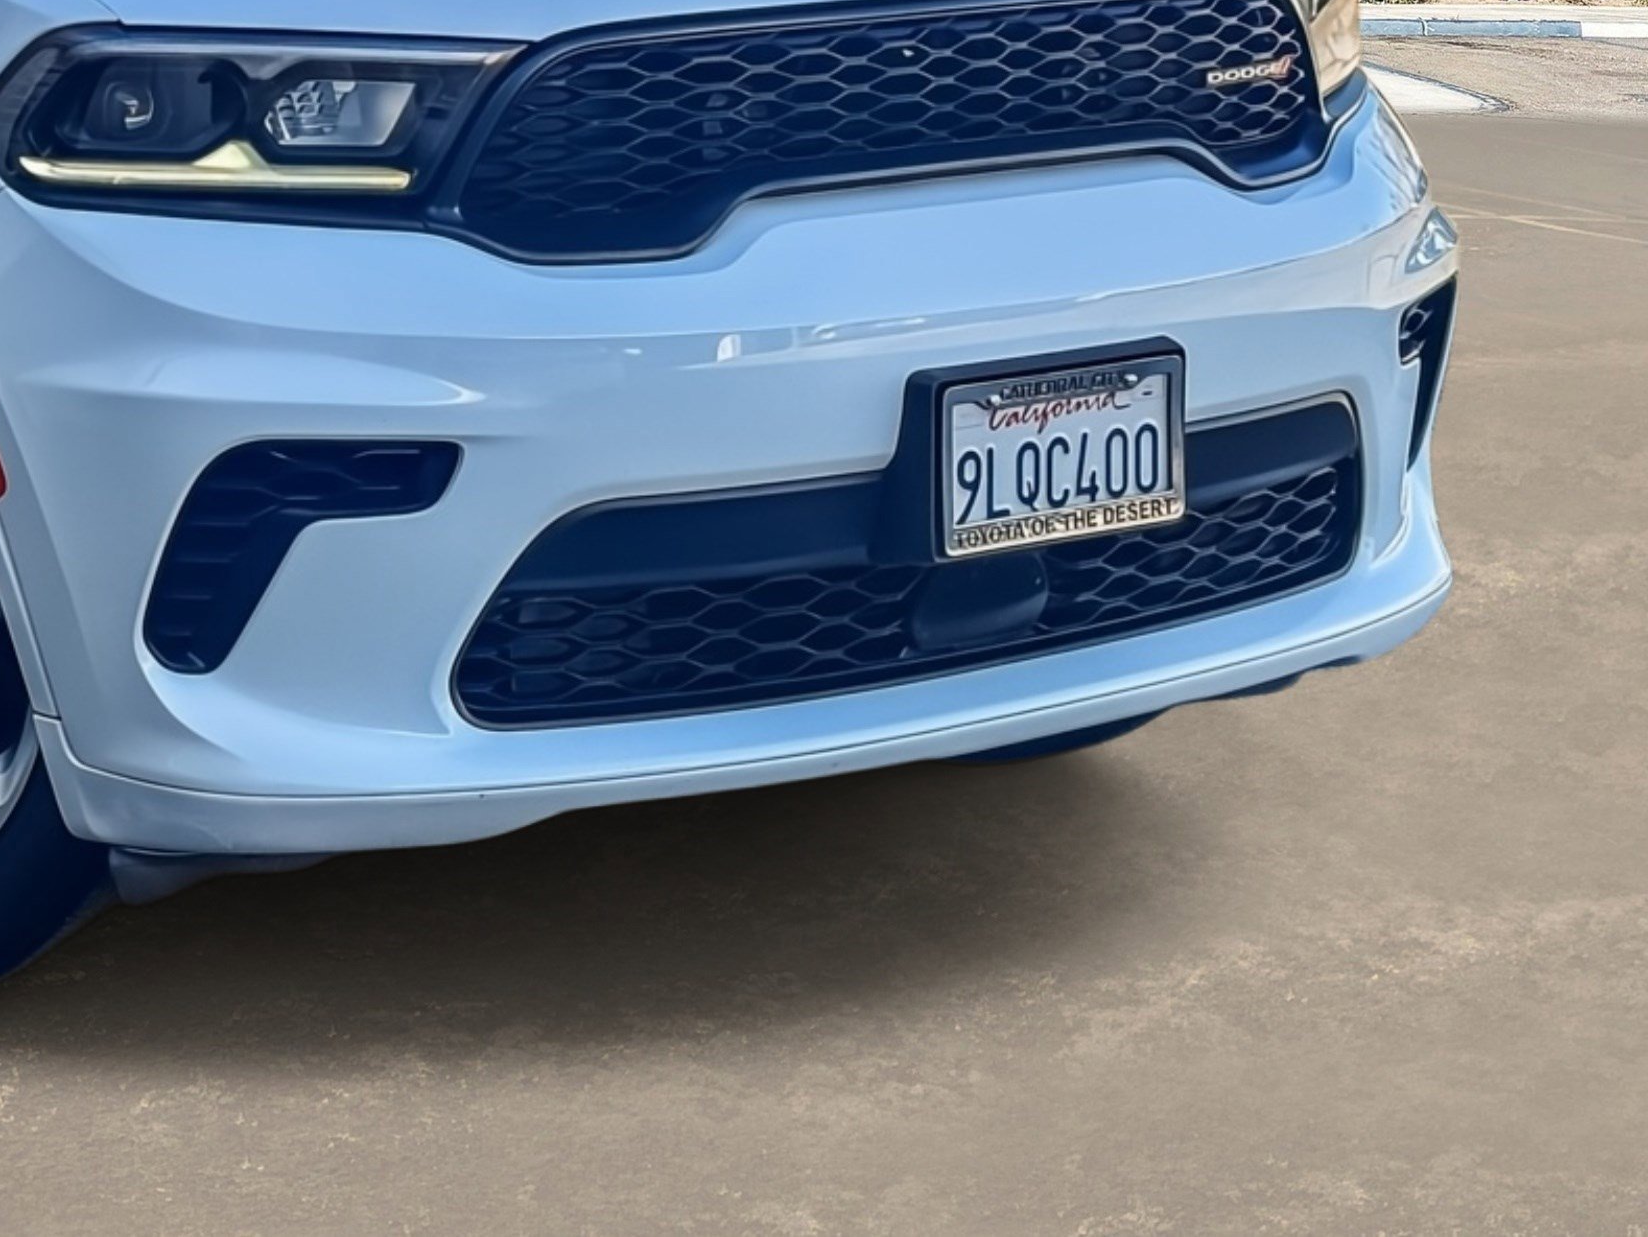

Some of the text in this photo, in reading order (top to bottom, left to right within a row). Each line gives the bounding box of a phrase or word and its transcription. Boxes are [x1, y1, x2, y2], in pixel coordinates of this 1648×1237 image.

[999, 374, 1087, 400] CATHEDRAL
[956, 422, 1159, 526] 9LQC400
[955, 498, 1175, 548] TOYOTA OF THE DESERT
